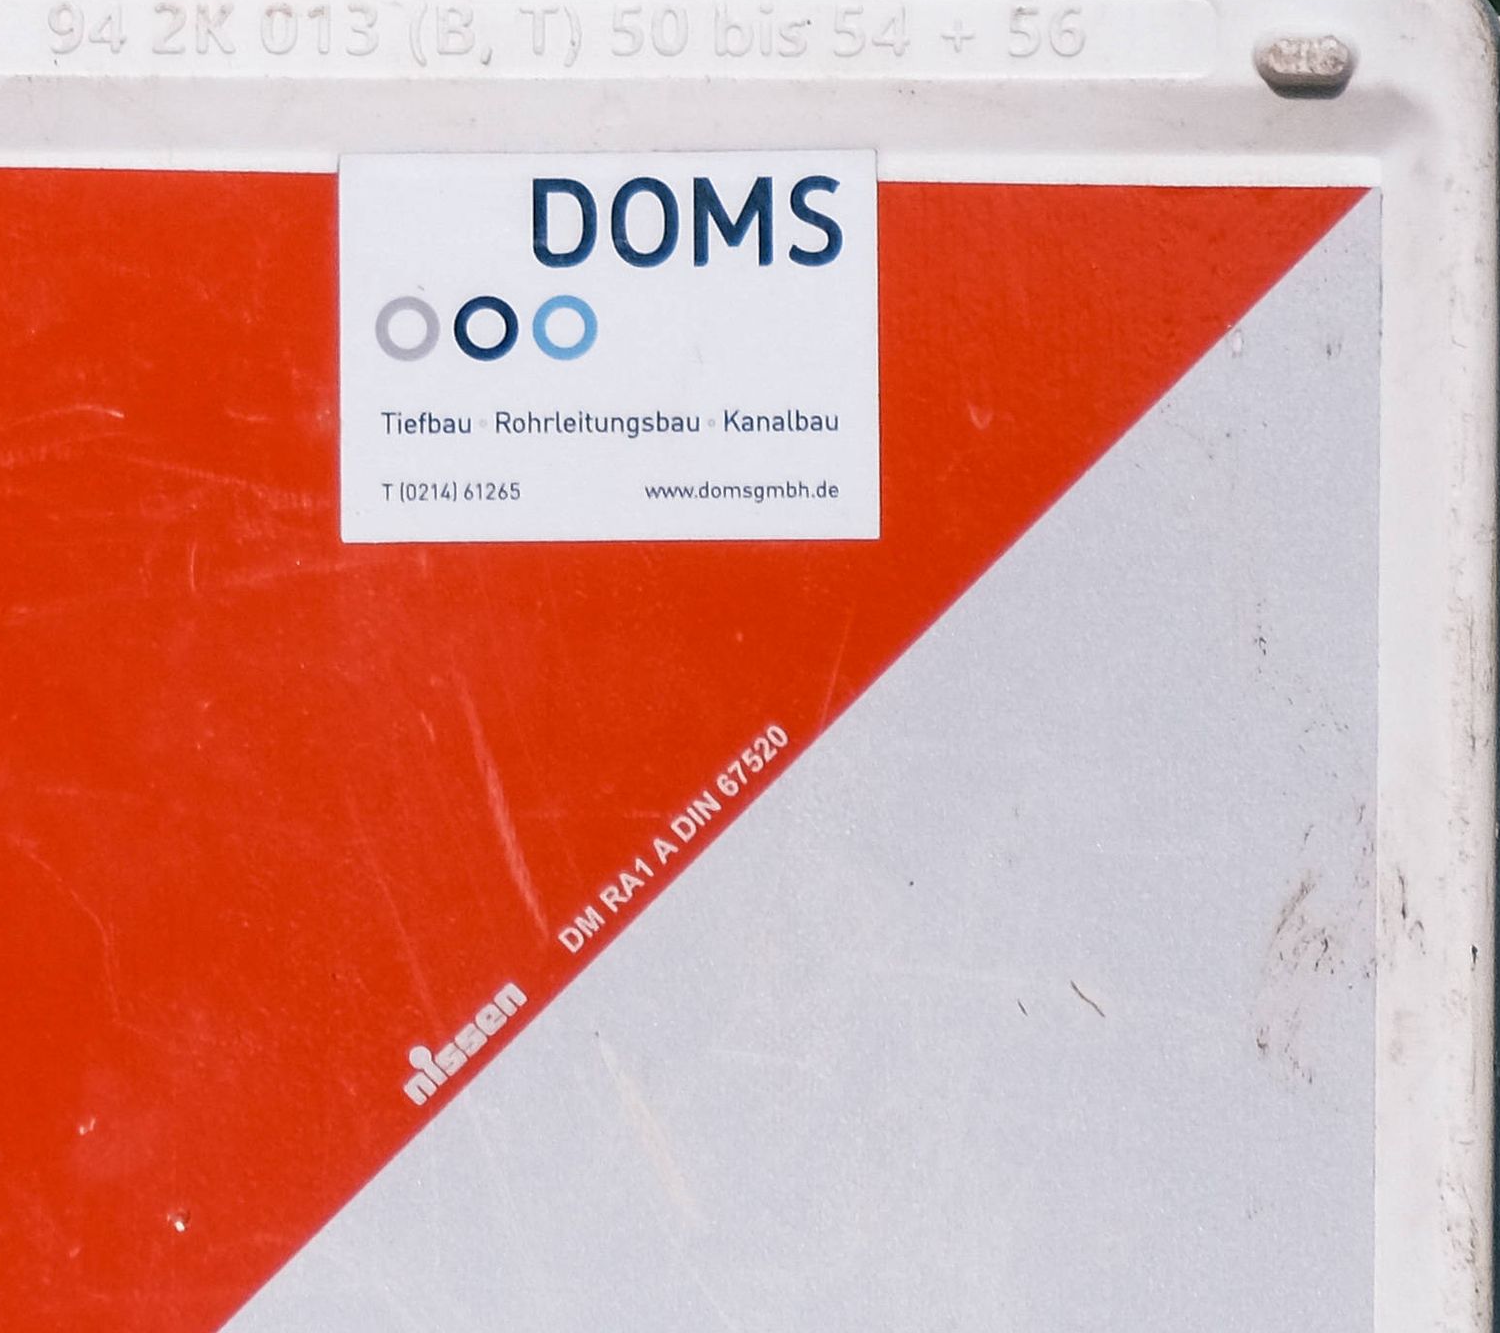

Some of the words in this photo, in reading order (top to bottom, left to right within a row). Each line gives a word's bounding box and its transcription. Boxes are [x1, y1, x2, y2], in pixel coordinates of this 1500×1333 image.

[47, 1, 127, 55] 94
[259, 1, 379, 56] 013
[518, 5, 582, 68] T)
[610, 4, 690, 57] 50
[714, 2, 809, 57] bis
[832, 4, 911, 58] 54
[1007, 5, 1087, 58] 56
[532, 175, 844, 268] DOMS
[380, 411, 473, 434] Tiefbau
[495, 410, 700, 438] Rohrleitungsbau
[723, 409, 839, 432] Kanalbau
[381, 482, 394, 501] T
[399, 481, 458, 502] (0214)
[463, 482, 521, 501] 61265
[644, 480, 840, 503] www.domsgmbh.de
[558, 906, 606, 954] DM
[599, 858, 654, 913] RA1
[652, 837, 679, 865] A
[670, 791, 722, 843] DIN
[716, 724, 789, 797] 67520
[403, 982, 528, 1106] nissen
